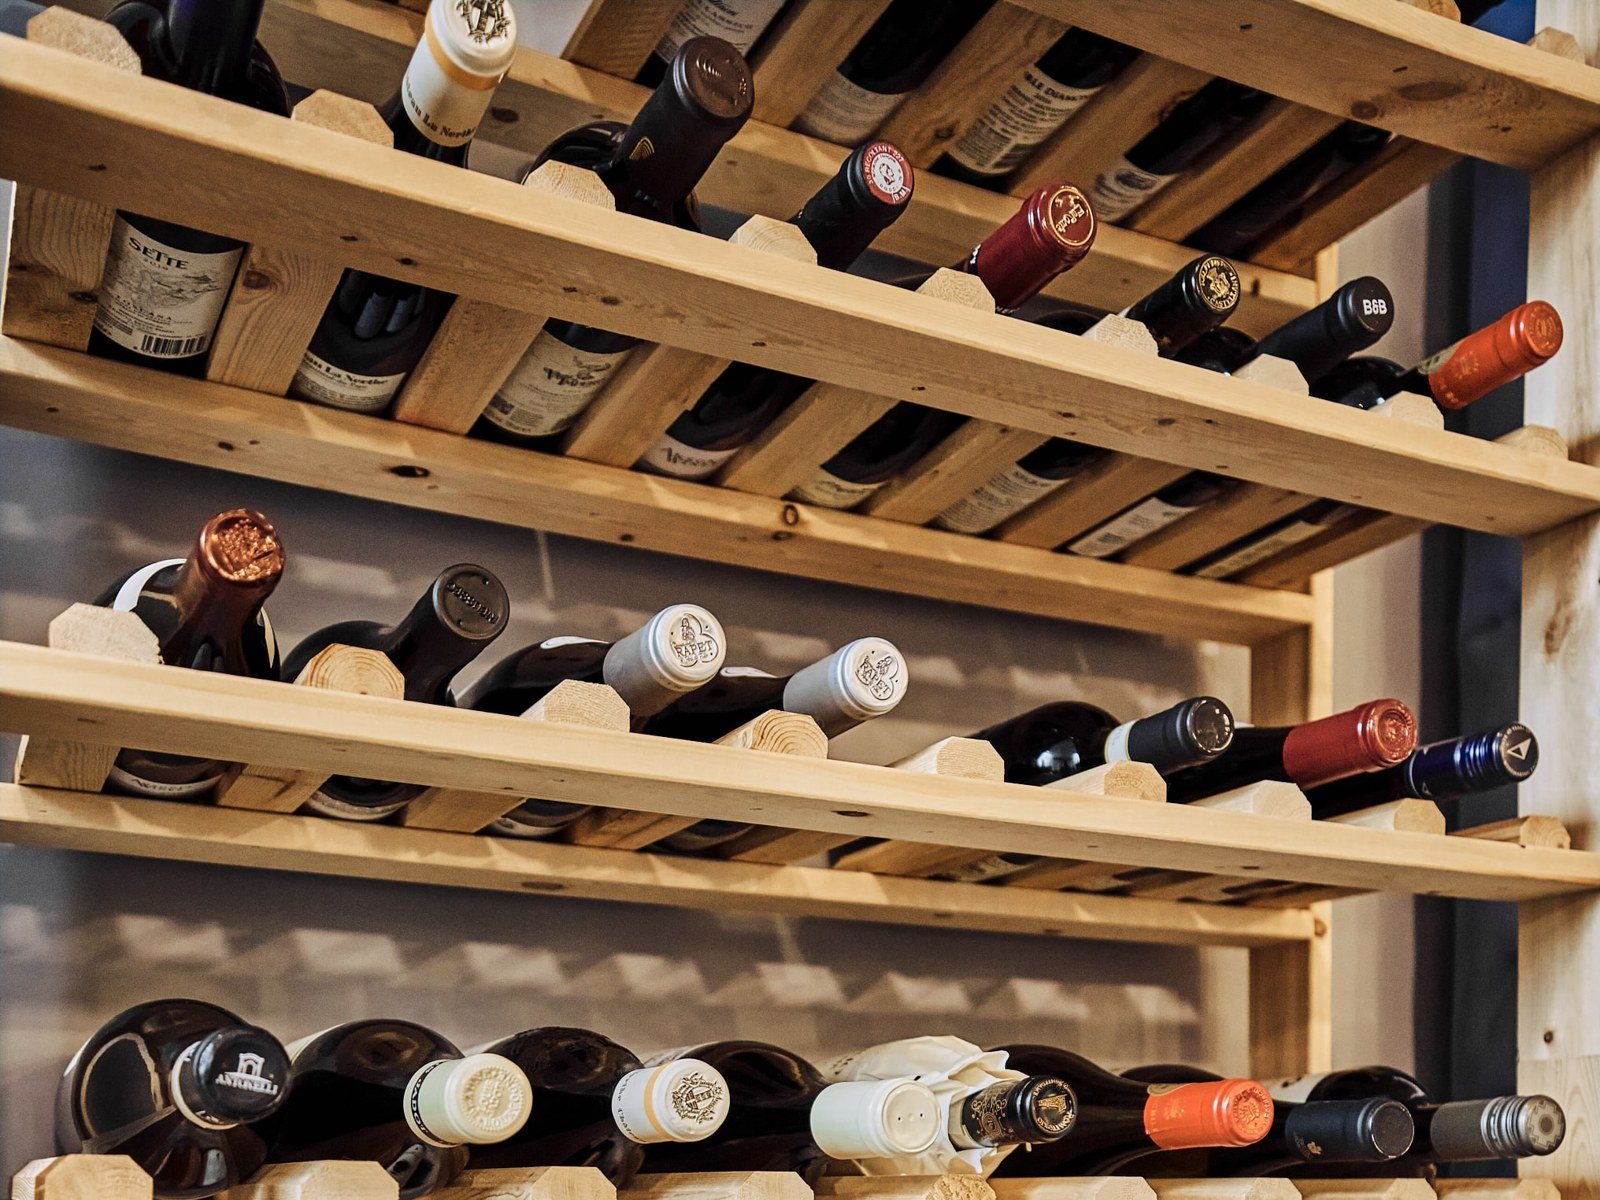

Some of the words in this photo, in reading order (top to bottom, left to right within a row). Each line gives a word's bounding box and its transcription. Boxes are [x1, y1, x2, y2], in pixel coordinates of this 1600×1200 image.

[864, 144, 892, 173] RECOLTANT
[128, 236, 190, 270] SETTE
[1362, 298, 1388, 316] B&B
[673, 640, 713, 658] RAPET
[859, 654, 890, 694] RAPET
[215, 1073, 279, 1096] ANTONELLI
